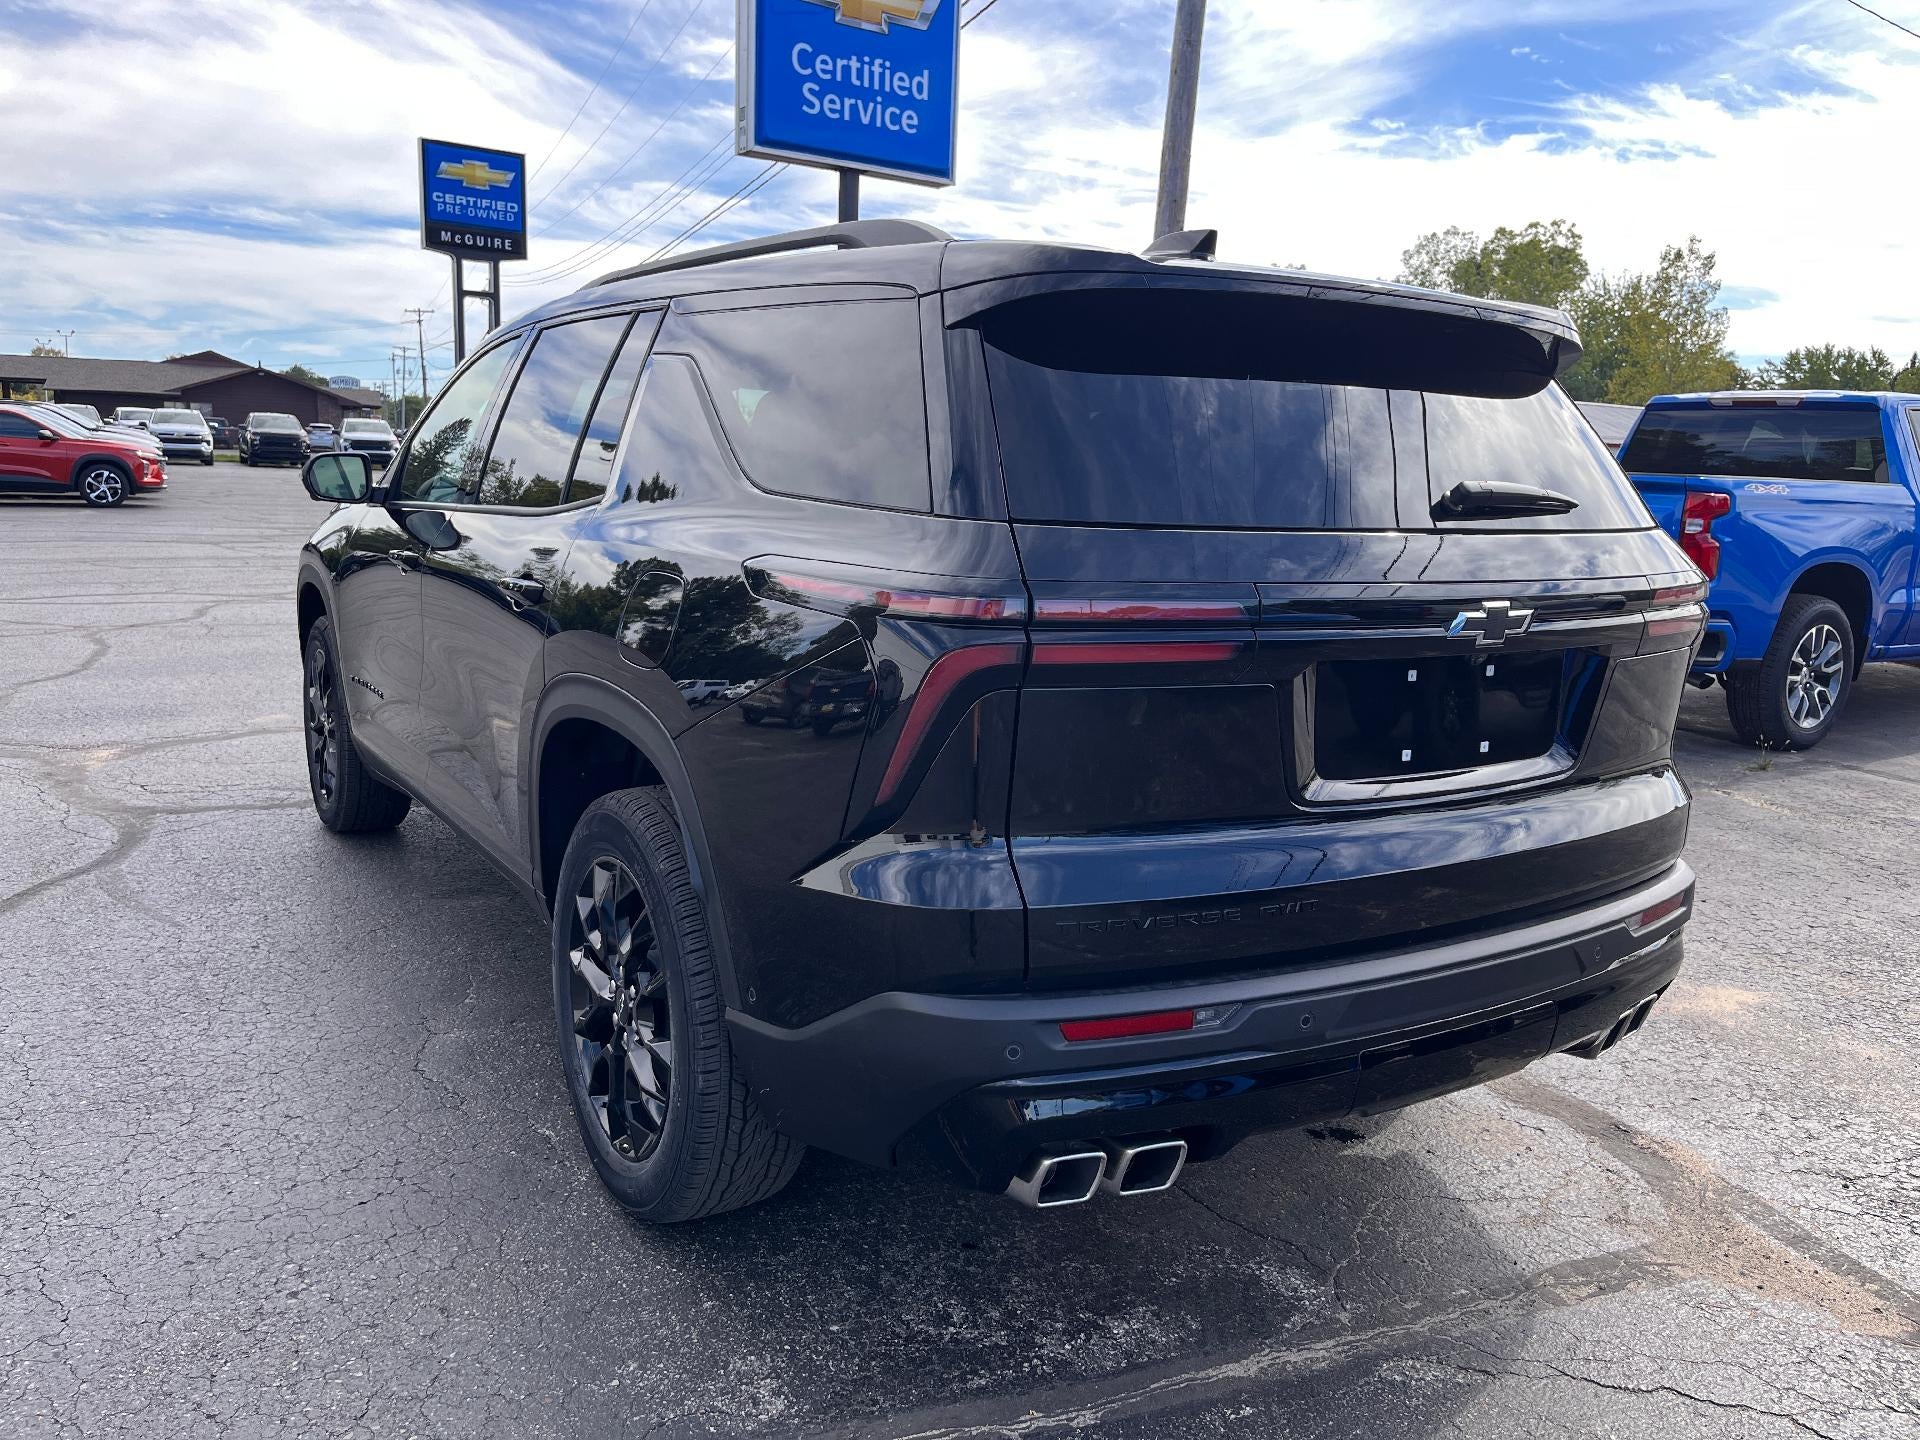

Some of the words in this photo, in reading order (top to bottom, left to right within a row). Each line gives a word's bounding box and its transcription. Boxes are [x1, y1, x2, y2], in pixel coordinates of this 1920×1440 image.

[791, 42, 930, 101] Certified
[801, 81, 919, 134] Service
[432, 191, 519, 213] CERTIFIED
[437, 203, 515, 222] PRE-OWNED
[440, 230, 513, 251] McGUIRE
[1055, 907, 1241, 935] TRAVERSE
